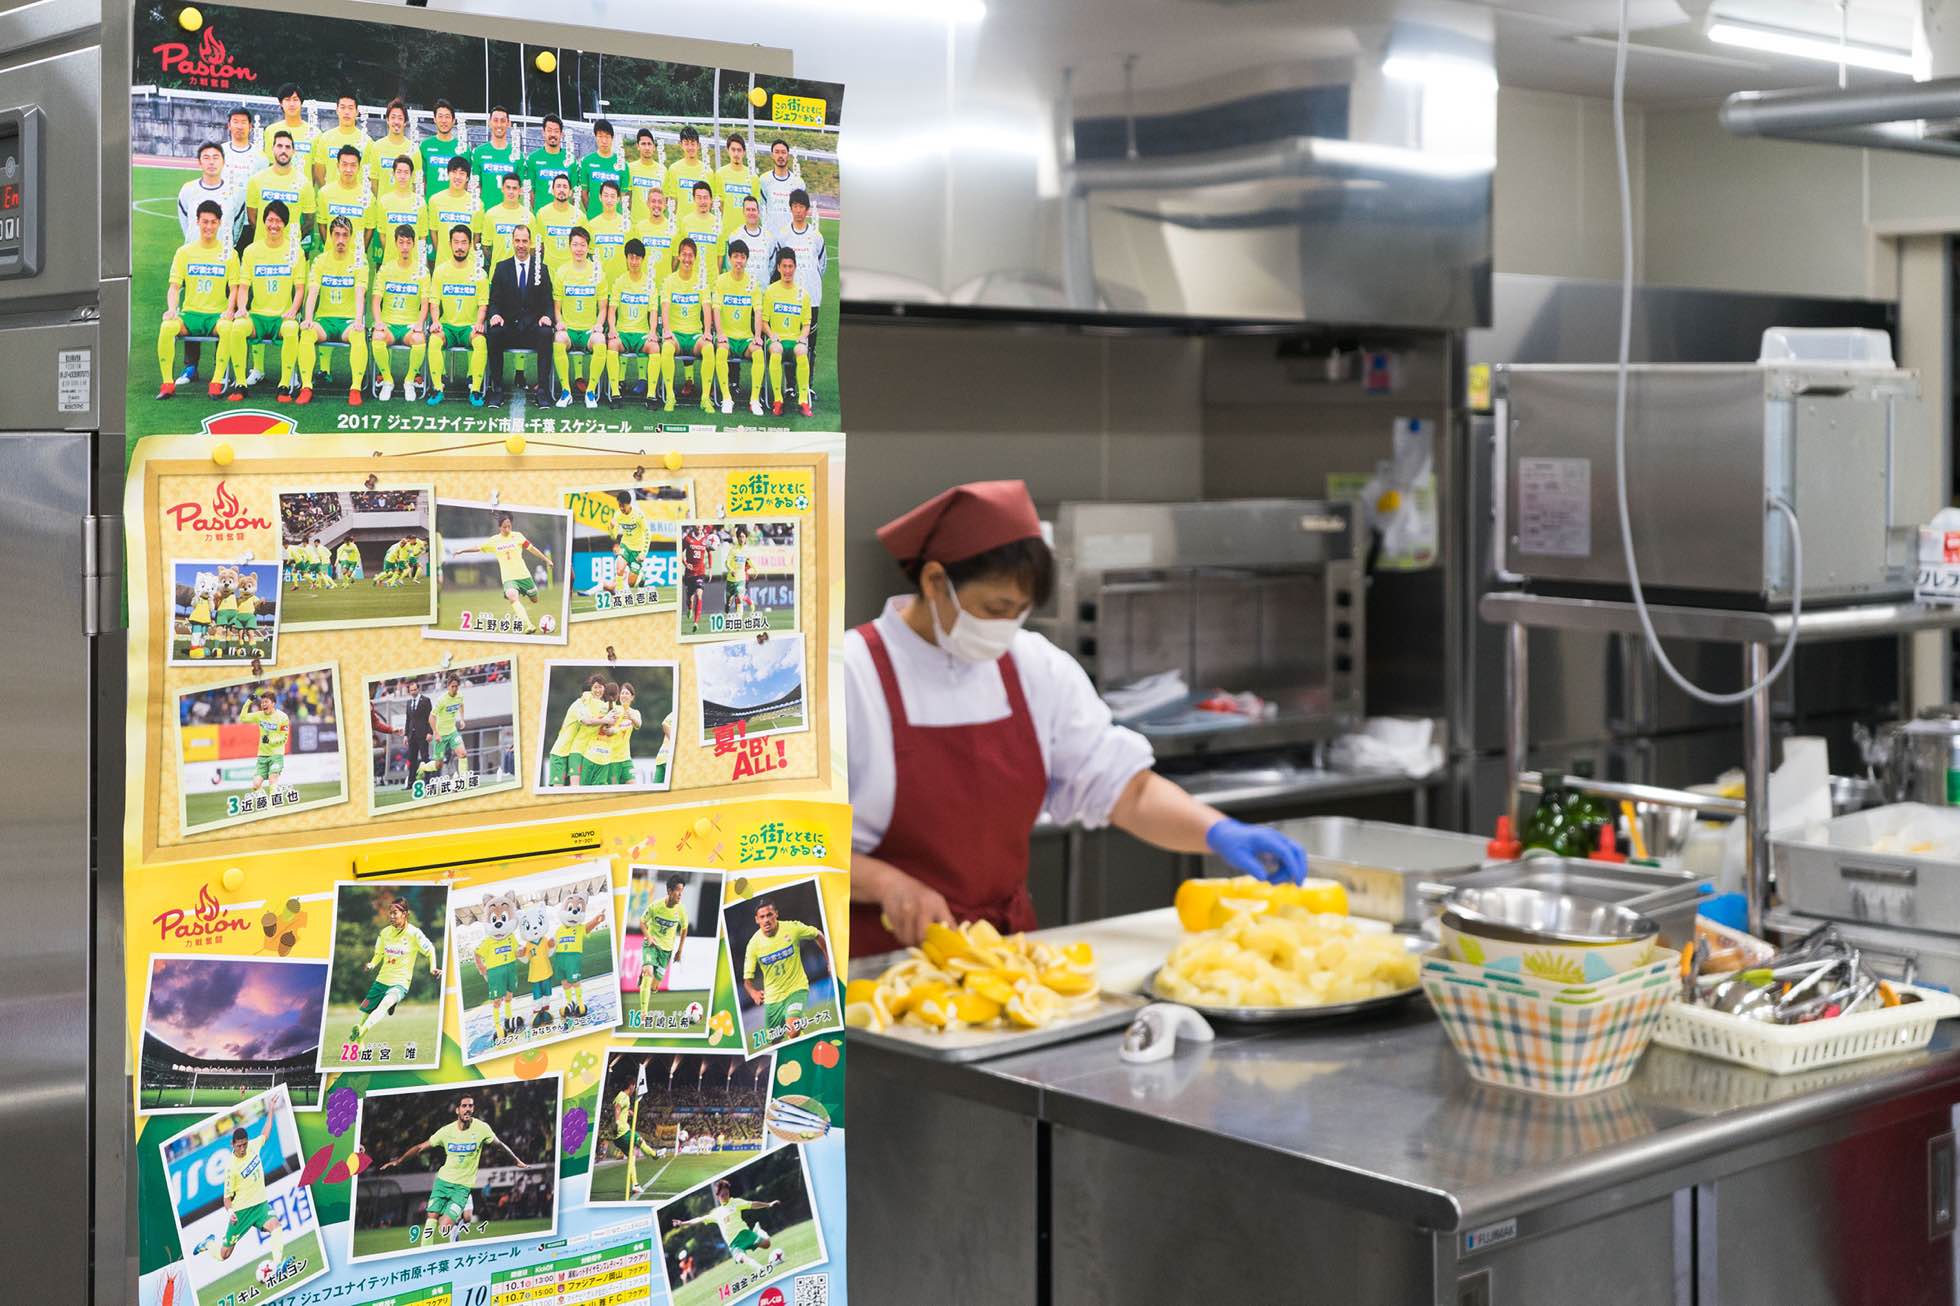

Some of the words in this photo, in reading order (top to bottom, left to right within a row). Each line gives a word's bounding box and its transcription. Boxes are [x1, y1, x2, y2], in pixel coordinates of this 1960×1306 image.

[338, 414, 381, 429] 2017
[388, 415, 556, 433] ジェフユナイテッド市原・千葉
[560, 419, 632, 433] スケジュール
[731, 474, 805, 495] この街とともに
[166, 502, 272, 532] Pasión
[597, 593, 611, 609] 32
[462, 612, 470, 629] 2
[711, 616, 724, 630] 10
[750, 736, 769, 757] BY
[732, 740, 788, 781] ALL!
[414, 782, 424, 797] 8
[229, 798, 239, 813] 3
[740, 823, 824, 846] この街とともに
[153, 908, 251, 940] Pasión
[629, 1009, 641, 1028] 16
[753, 1030, 768, 1048] 21
[341, 1044, 359, 1061] 28
[409, 1226, 420, 1241] 9
[454, 1245, 521, 1269] スケジュール
[535, 1287, 554, 1297] 15:00
[568, 1272, 623, 1291] ファジアーノ岡山
[718, 1283, 731, 1301] 14
[750, 1261, 773, 1282] みどり
[238, 1286, 260, 1302] キム
[464, 1284, 487, 1306] 10
